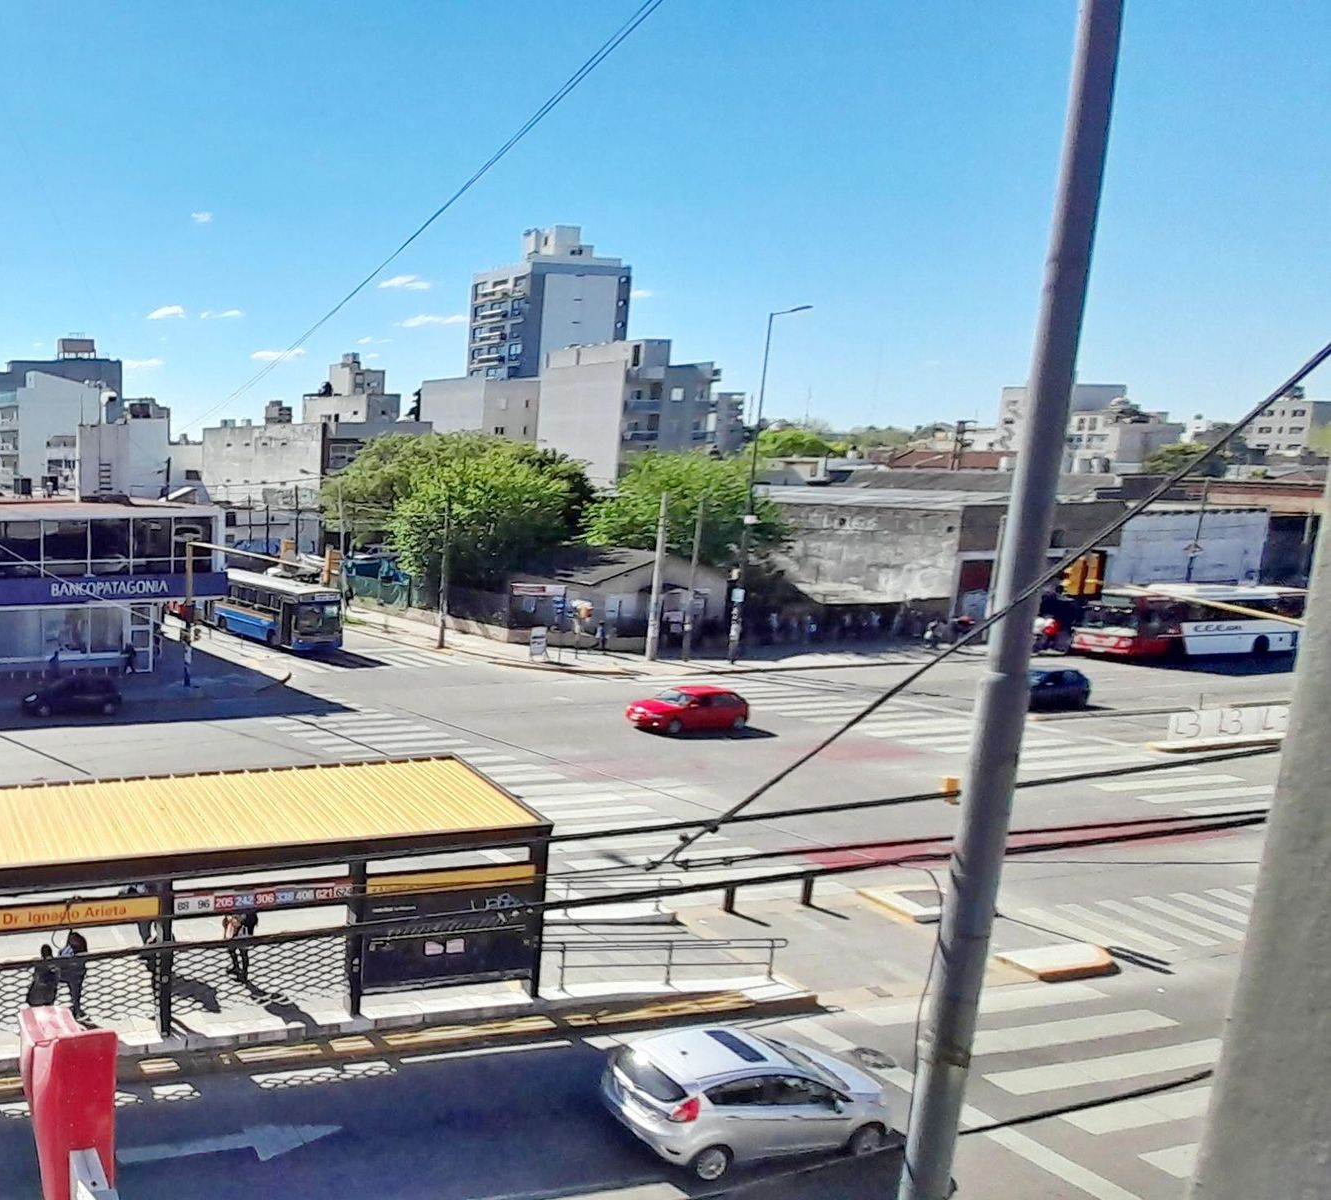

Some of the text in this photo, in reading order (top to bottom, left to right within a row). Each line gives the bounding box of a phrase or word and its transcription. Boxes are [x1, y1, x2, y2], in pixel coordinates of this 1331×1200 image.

[51, 579, 169, 598] BANCOPATAGONIA
[198, 899, 211, 910] 96
[215, 896, 234, 908] 205
[235, 894, 255, 906] 242
[255, 893, 275, 904] 306
[2, 904, 127, 926] Dr. Ignacio Arieta
